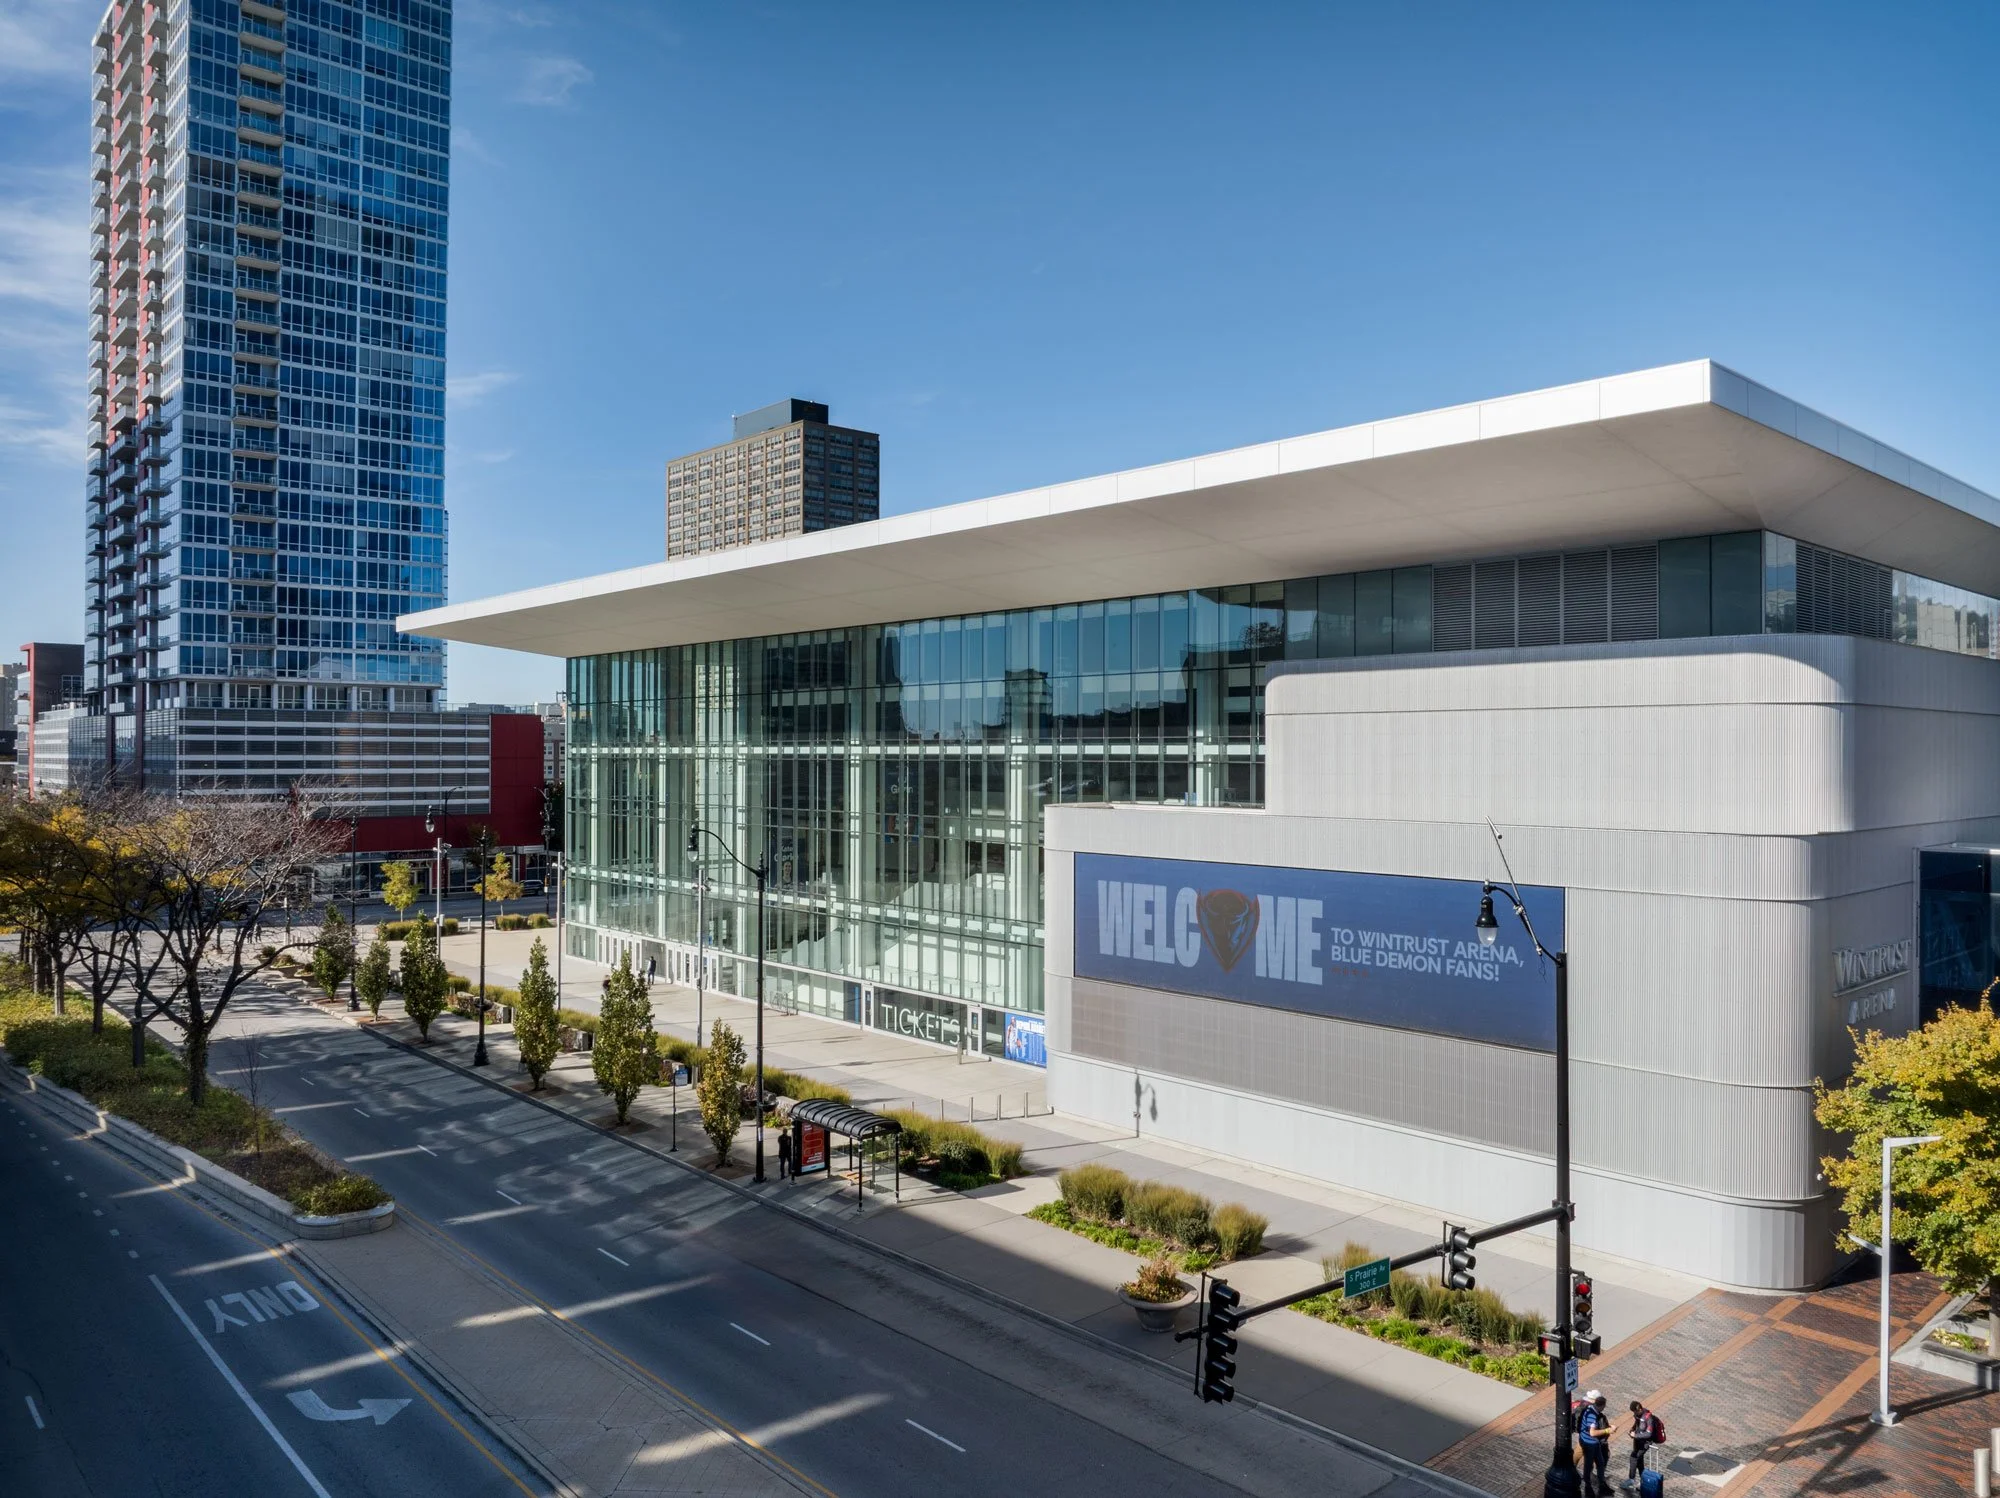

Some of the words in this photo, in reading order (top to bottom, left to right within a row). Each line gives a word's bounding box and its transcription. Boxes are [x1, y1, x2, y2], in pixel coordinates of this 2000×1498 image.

[1098, 880, 1323, 985] WELCME
[1331, 927, 1354, 945] TO
[1359, 930, 1449, 957] WINTRUST
[1453, 941, 1524, 968] ARENA,
[1331, 946, 1371, 965] BLUE
[1376, 951, 1441, 974] DEMON
[1446, 959, 1499, 982] FANS!
[1832, 939, 1912, 989] WINTRUST
[1848, 988, 1897, 1024] ARENA
[881, 1003, 960, 1046] TICKETS
[1350, 1274, 1354, 1282] S
[1355, 1266, 1378, 1281] Prairie
[1372, 1278, 1377, 1286] E
[204, 1281, 320, 1333] ONLY
[1566, 1361, 1577, 1370] ONE
[1567, 1369, 1577, 1380] WAY
